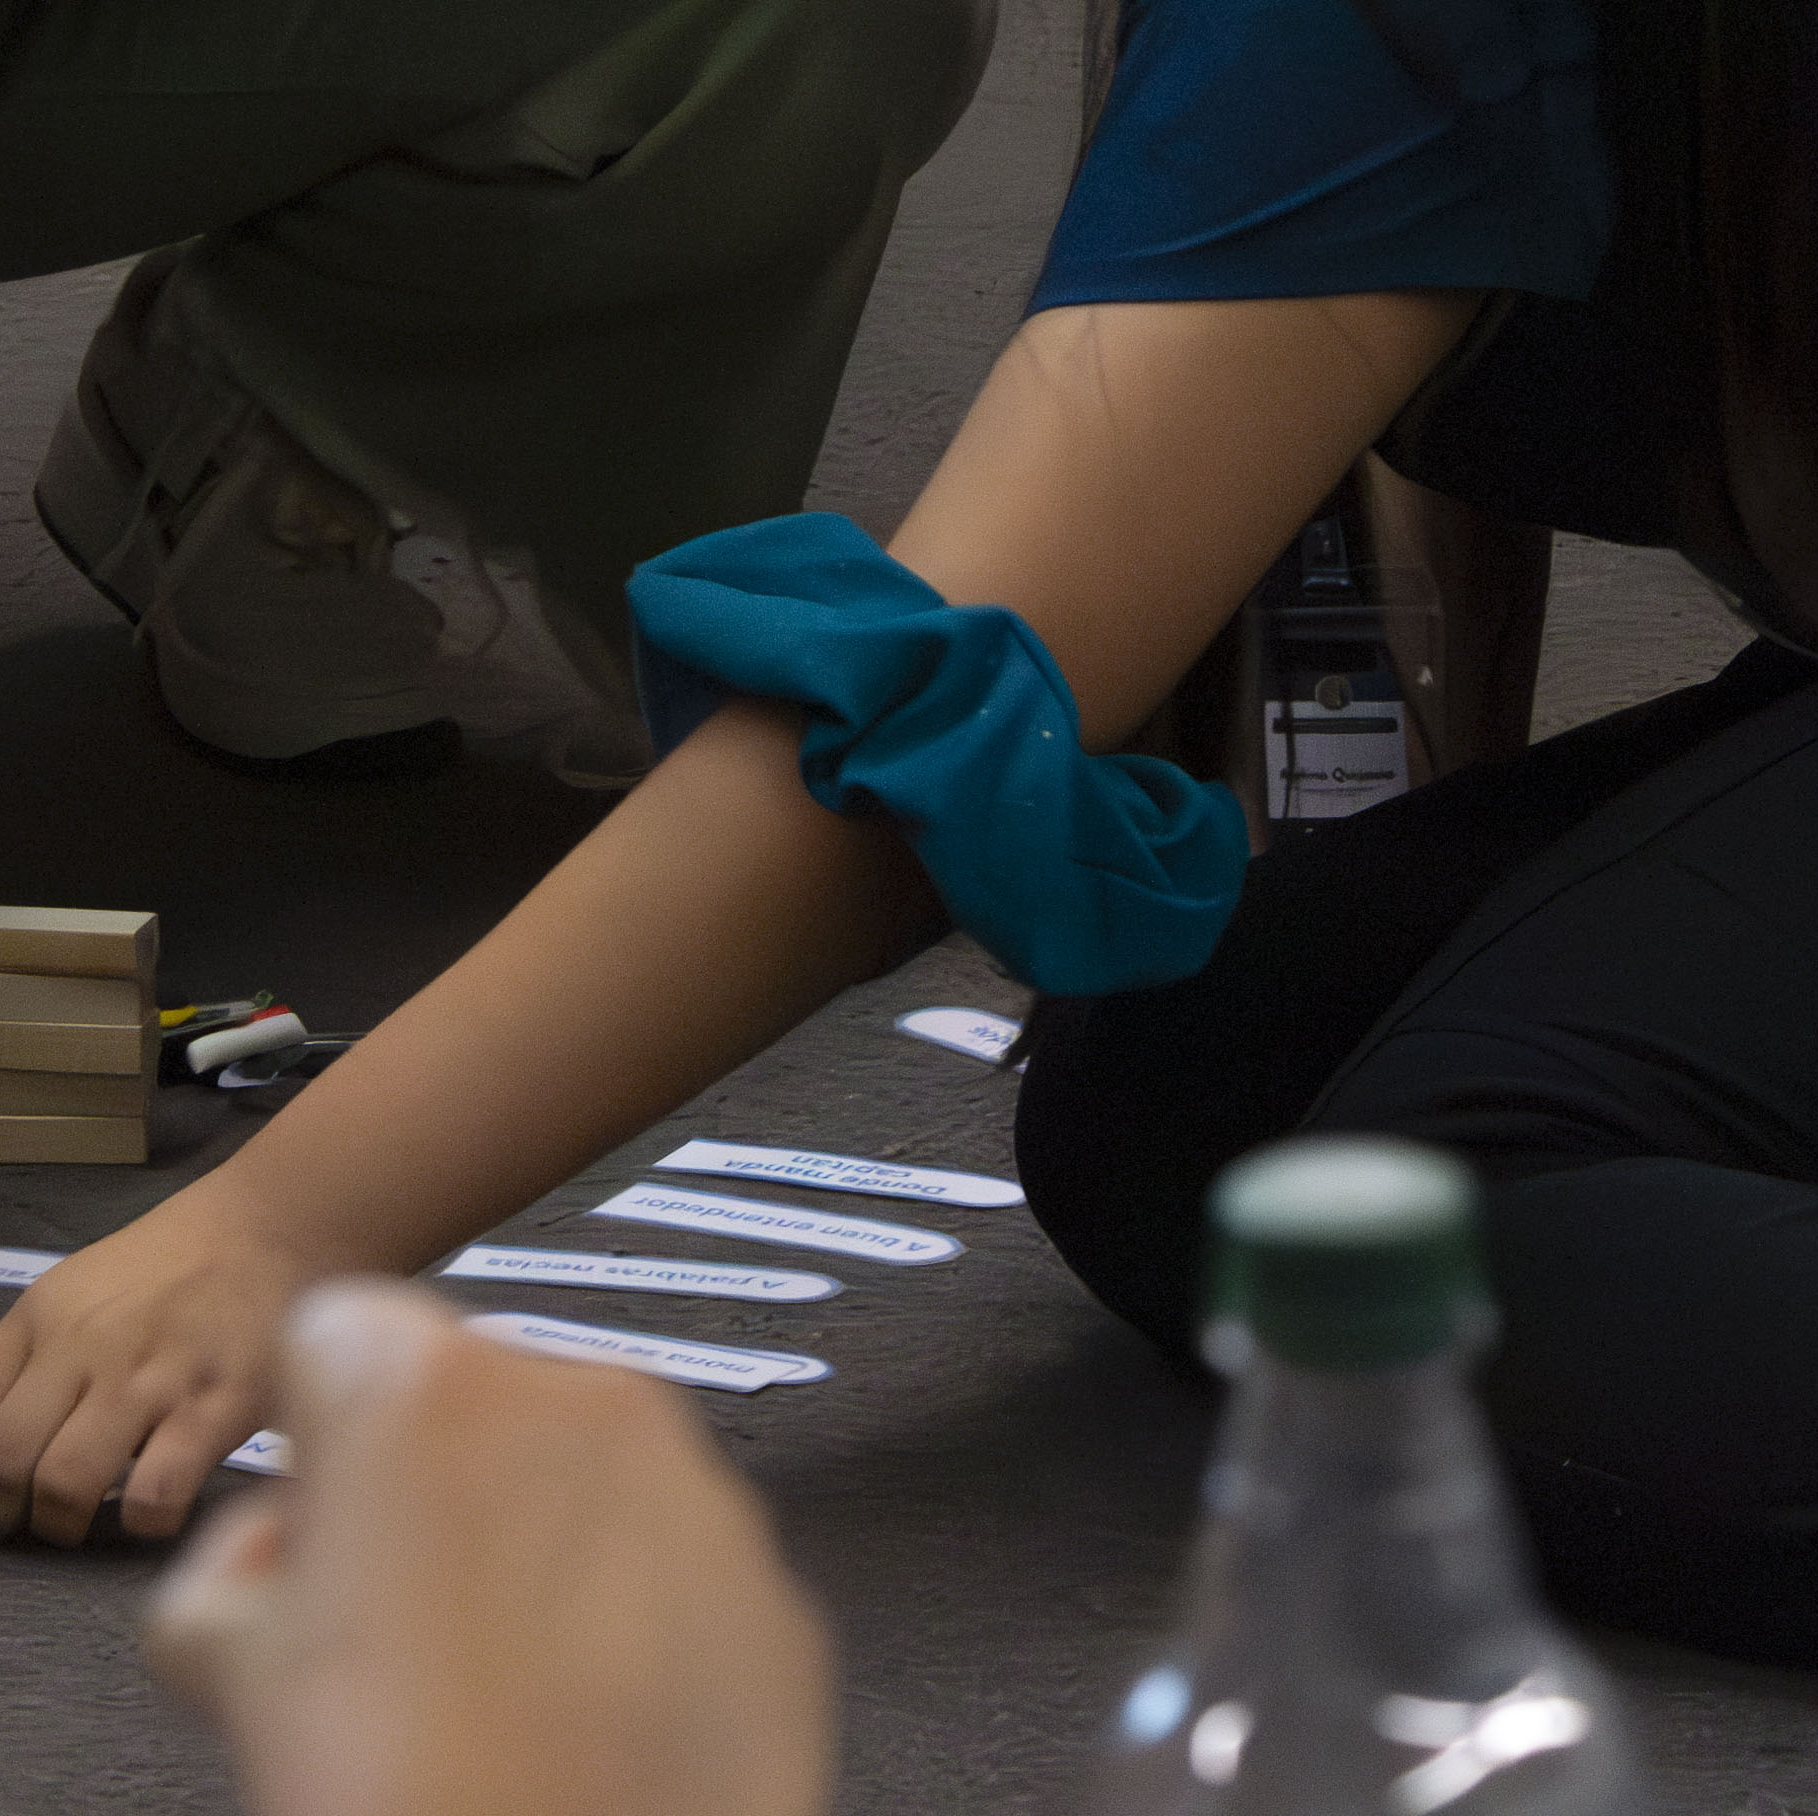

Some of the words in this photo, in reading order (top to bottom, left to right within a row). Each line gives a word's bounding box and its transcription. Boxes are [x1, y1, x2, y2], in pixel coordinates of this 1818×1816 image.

[723, 1160, 832, 1181] manda
[838, 1175, 948, 1195] Donde
[629, 1197, 815, 1231] entendedor
[819, 1226, 901, 1248] buen
[908, 1240, 930, 1253] A
[484, 1258, 594, 1274] necias
[605, 1266, 757, 1288] palabras
[761, 1280, 787, 1291] A
[664, 1352, 756, 1374] mona
